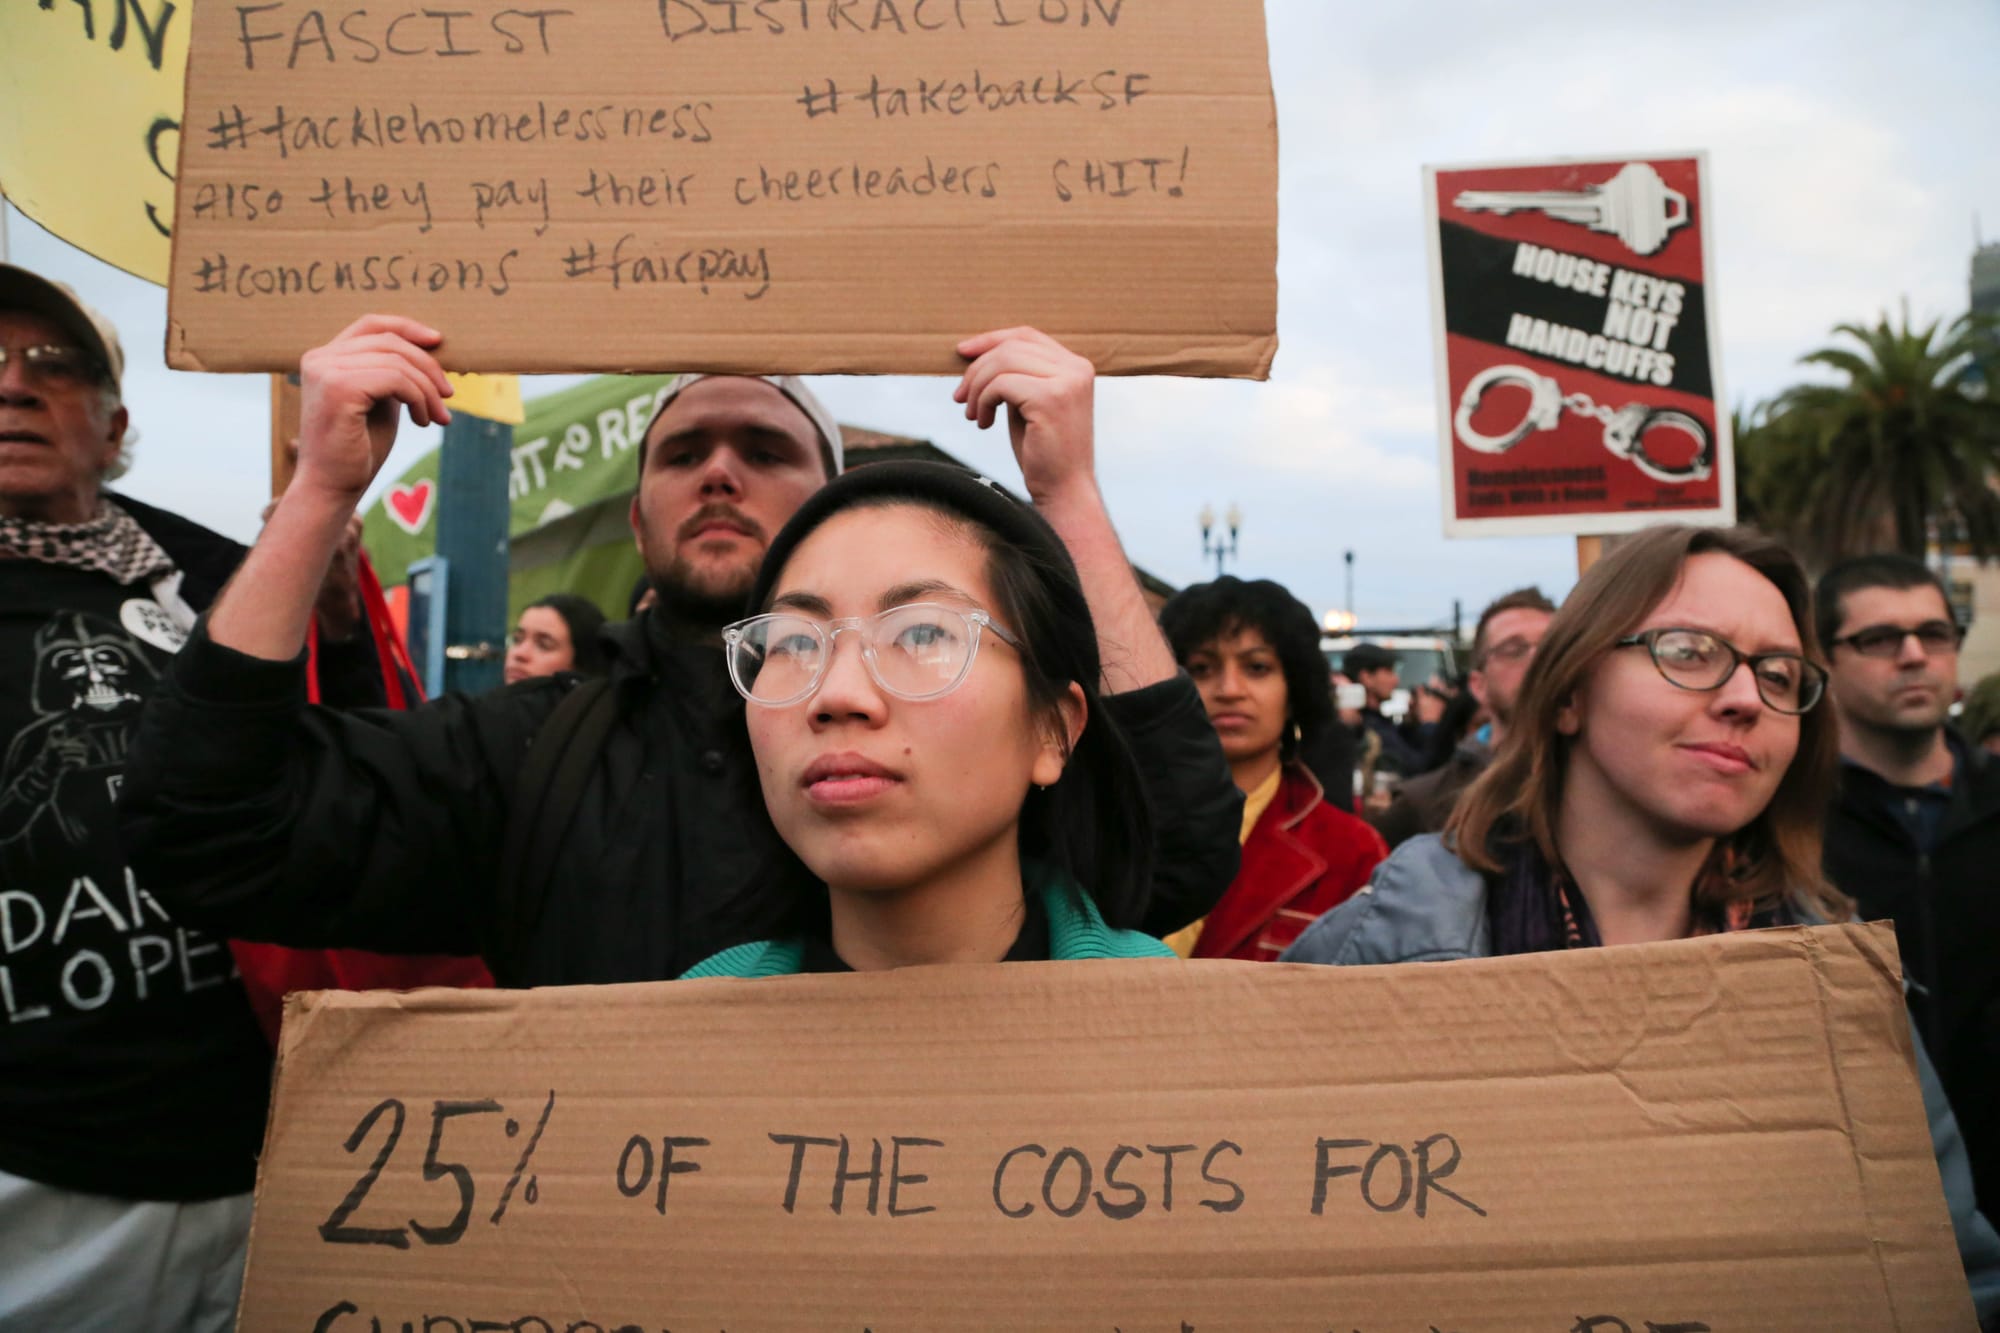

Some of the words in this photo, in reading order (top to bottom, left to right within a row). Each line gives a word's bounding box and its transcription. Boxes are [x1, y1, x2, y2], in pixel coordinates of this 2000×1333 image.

[237, 4, 574, 70] FASCIST
[797, 69, 1150, 119] #takebackSF
[206, 101, 713, 158] #tacklehomelessness
[310, 177, 432, 232] they
[473, 182, 549, 236] pay
[576, 169, 690, 207] their
[734, 156, 999, 203] cheerleaders
[1055, 145, 1190, 202] SHIT!
[562, 234, 772, 299] #fairpay
[1513, 243, 1610, 298] HOUSE
[1609, 269, 1685, 316] KEYS
[1506, 312, 1675, 387] HANDCUFFS
[1602, 304, 1679, 351] NOT
[0, 926, 241, 1023] LOPE
[318, 1089, 555, 1249] 25%
[616, 1134, 710, 1215] OF
[768, 1133, 944, 1217] THE
[993, 1139, 1246, 1219] COSTS
[1310, 1131, 1487, 1217] FOR
